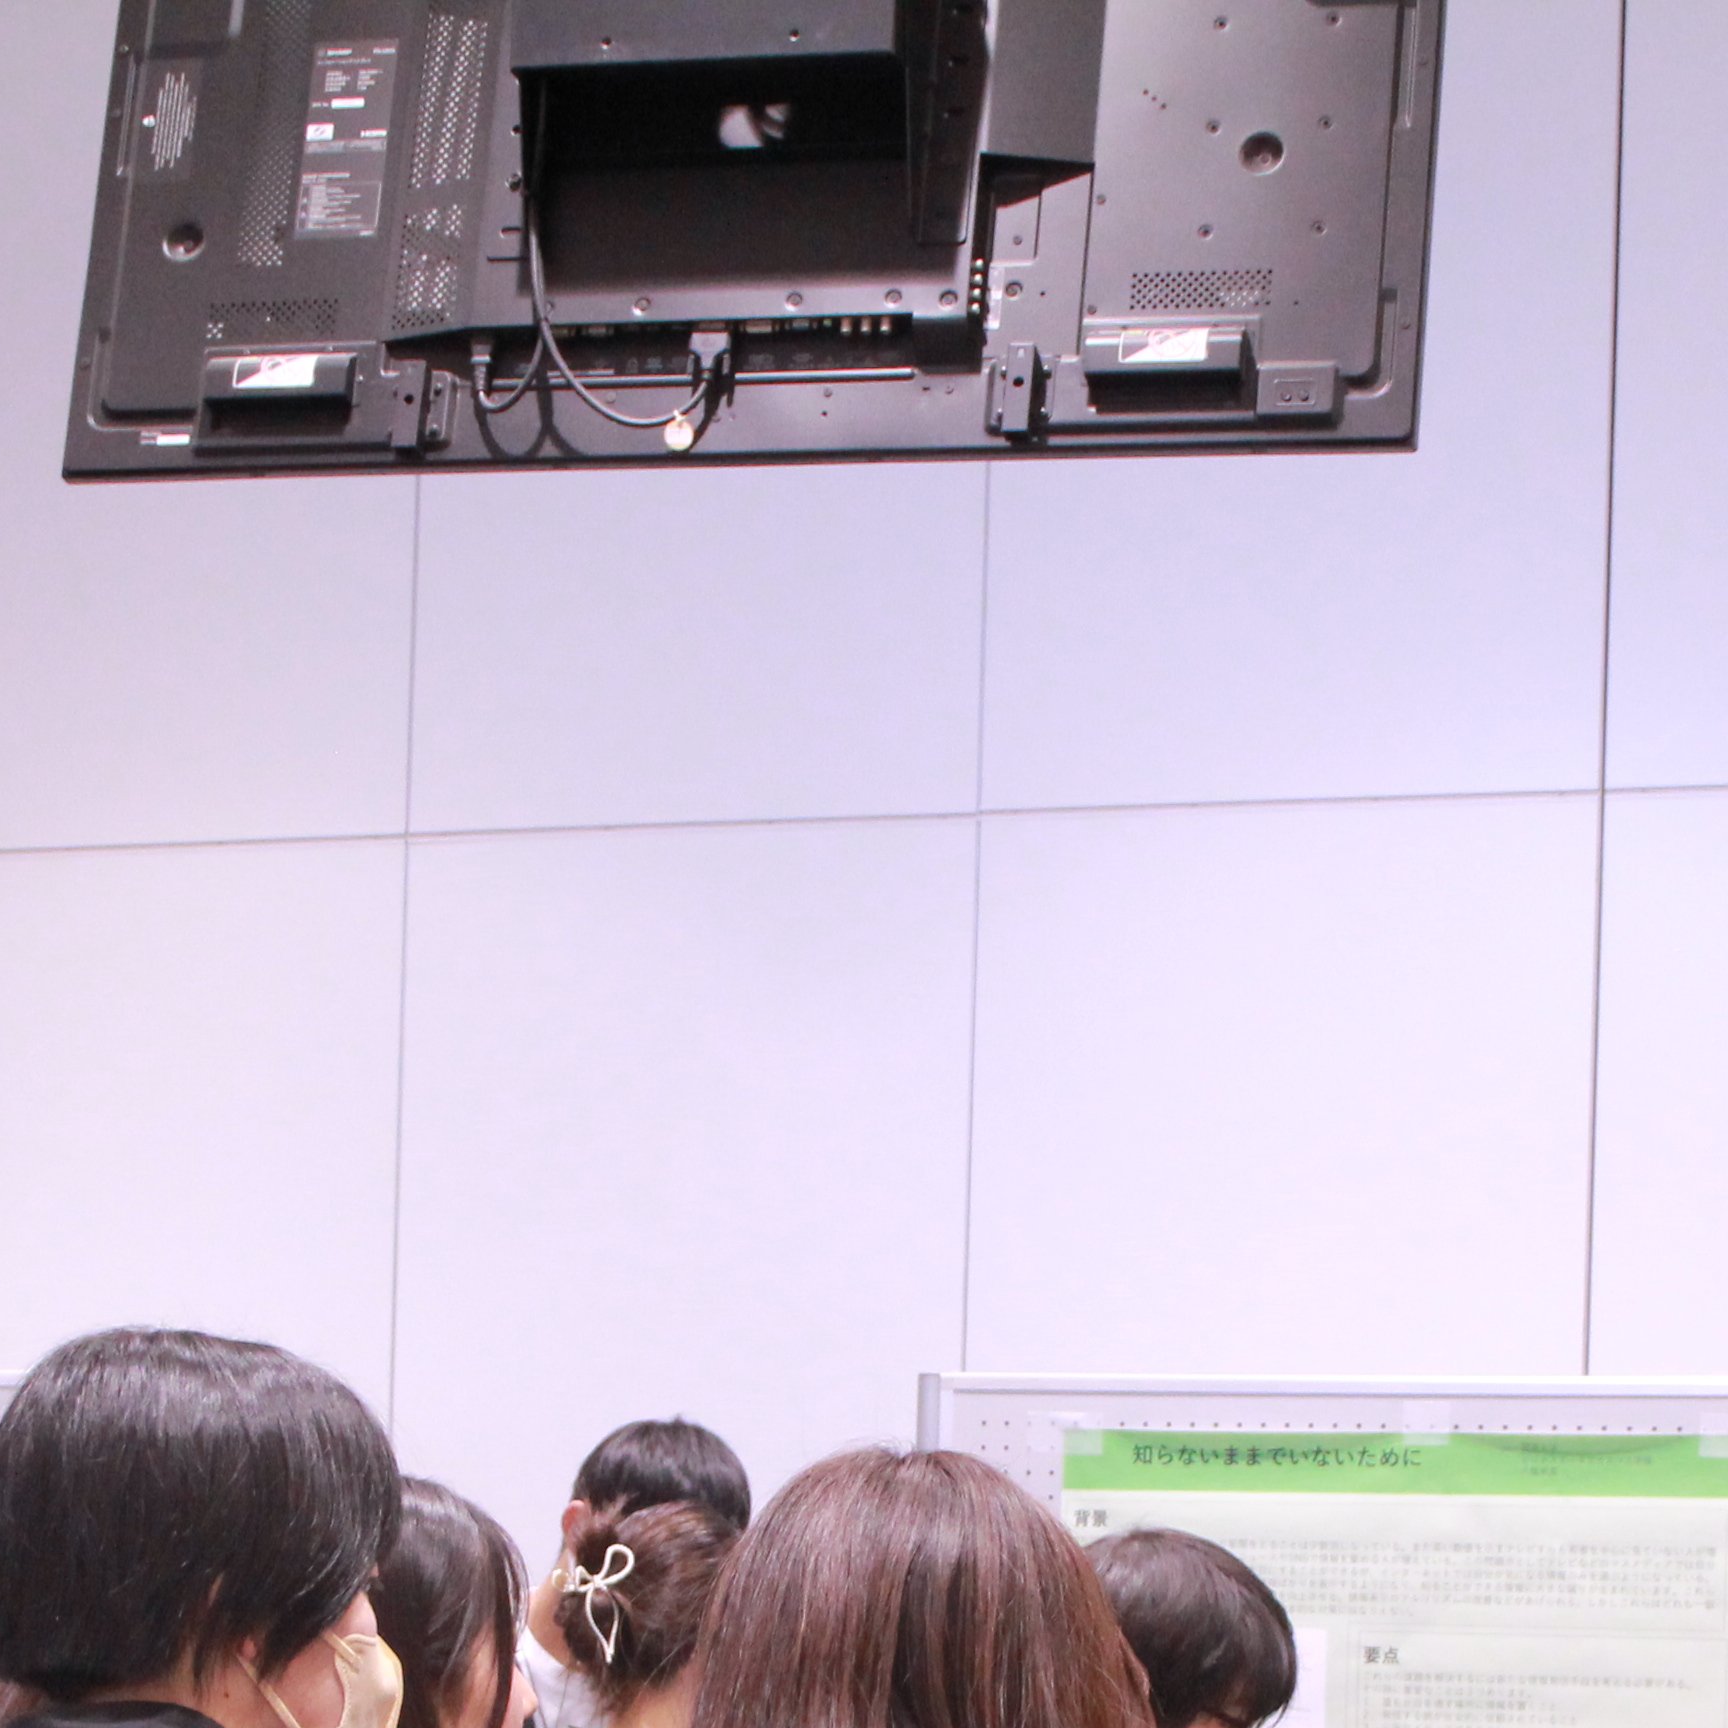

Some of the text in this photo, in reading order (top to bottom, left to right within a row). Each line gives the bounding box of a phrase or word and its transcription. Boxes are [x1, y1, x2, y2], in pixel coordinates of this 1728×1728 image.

[1132, 1443, 1422, 1468] 知らないままでいないために
[1074, 1509, 1109, 1529] 背景
[1362, 1646, 1401, 1665] 要点
